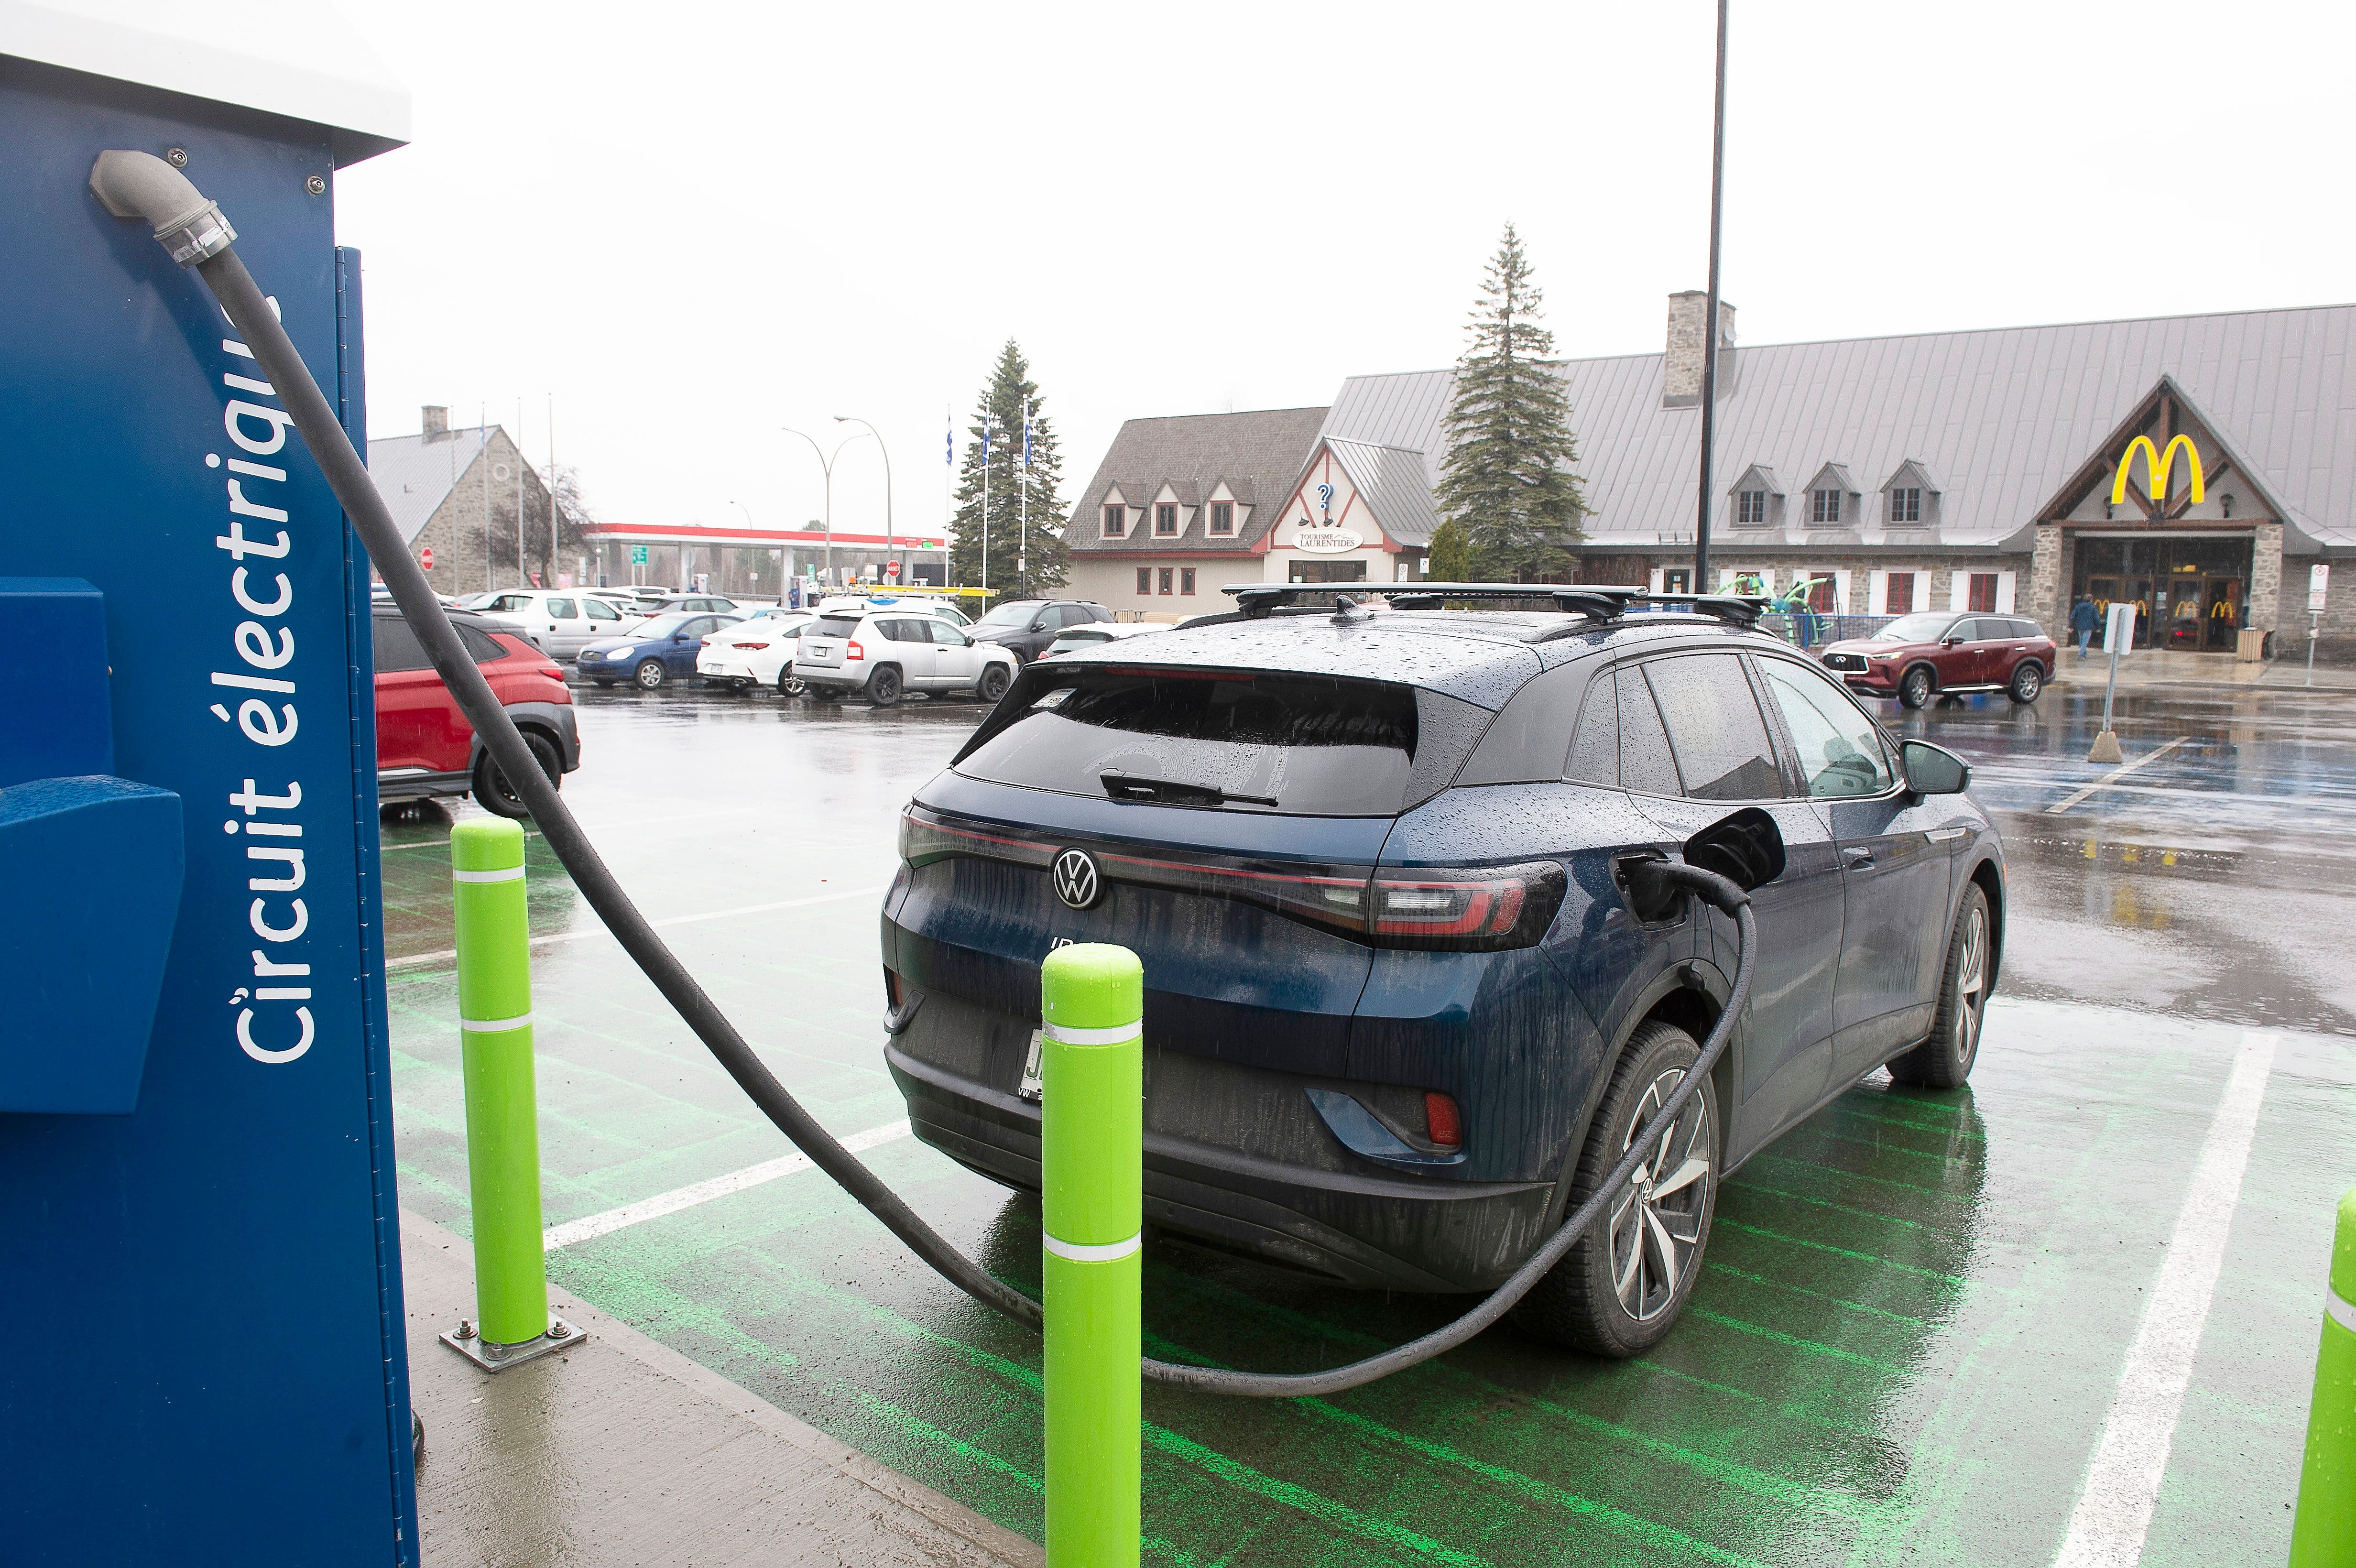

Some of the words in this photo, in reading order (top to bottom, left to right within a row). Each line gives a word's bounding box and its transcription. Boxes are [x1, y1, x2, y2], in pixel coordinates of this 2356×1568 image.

[205, 295, 299, 746] électriqu
[224, 778, 315, 1064] Circuit
[1018, 1087, 1031, 1098] VW
